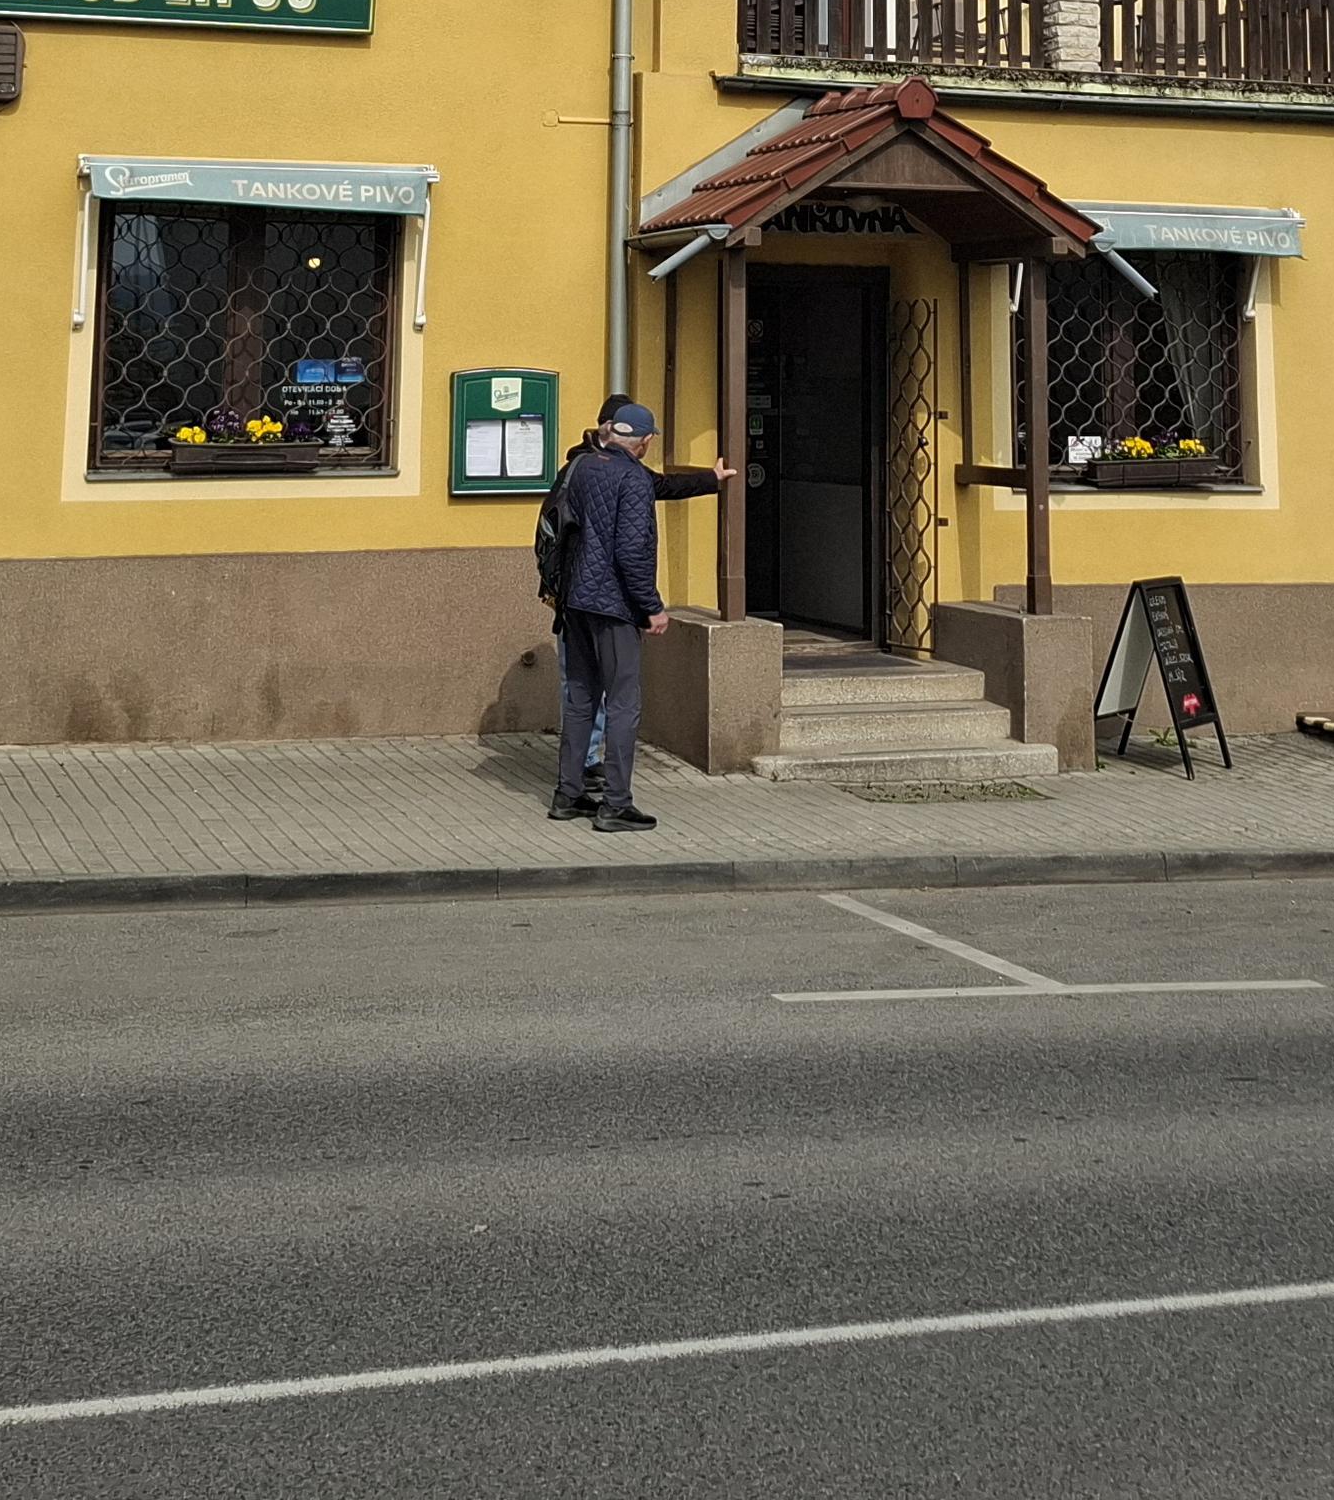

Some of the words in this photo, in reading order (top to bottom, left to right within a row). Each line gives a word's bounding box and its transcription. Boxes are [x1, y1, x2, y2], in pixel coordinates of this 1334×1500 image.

[104, 165, 195, 196] Staropramen
[232, 179, 353, 202] TANKOVÉ
[360, 185, 415, 205] PIVO
[1145, 224, 1243, 245] TANKOVÉ
[1246, 230, 1291, 249] PIVO
